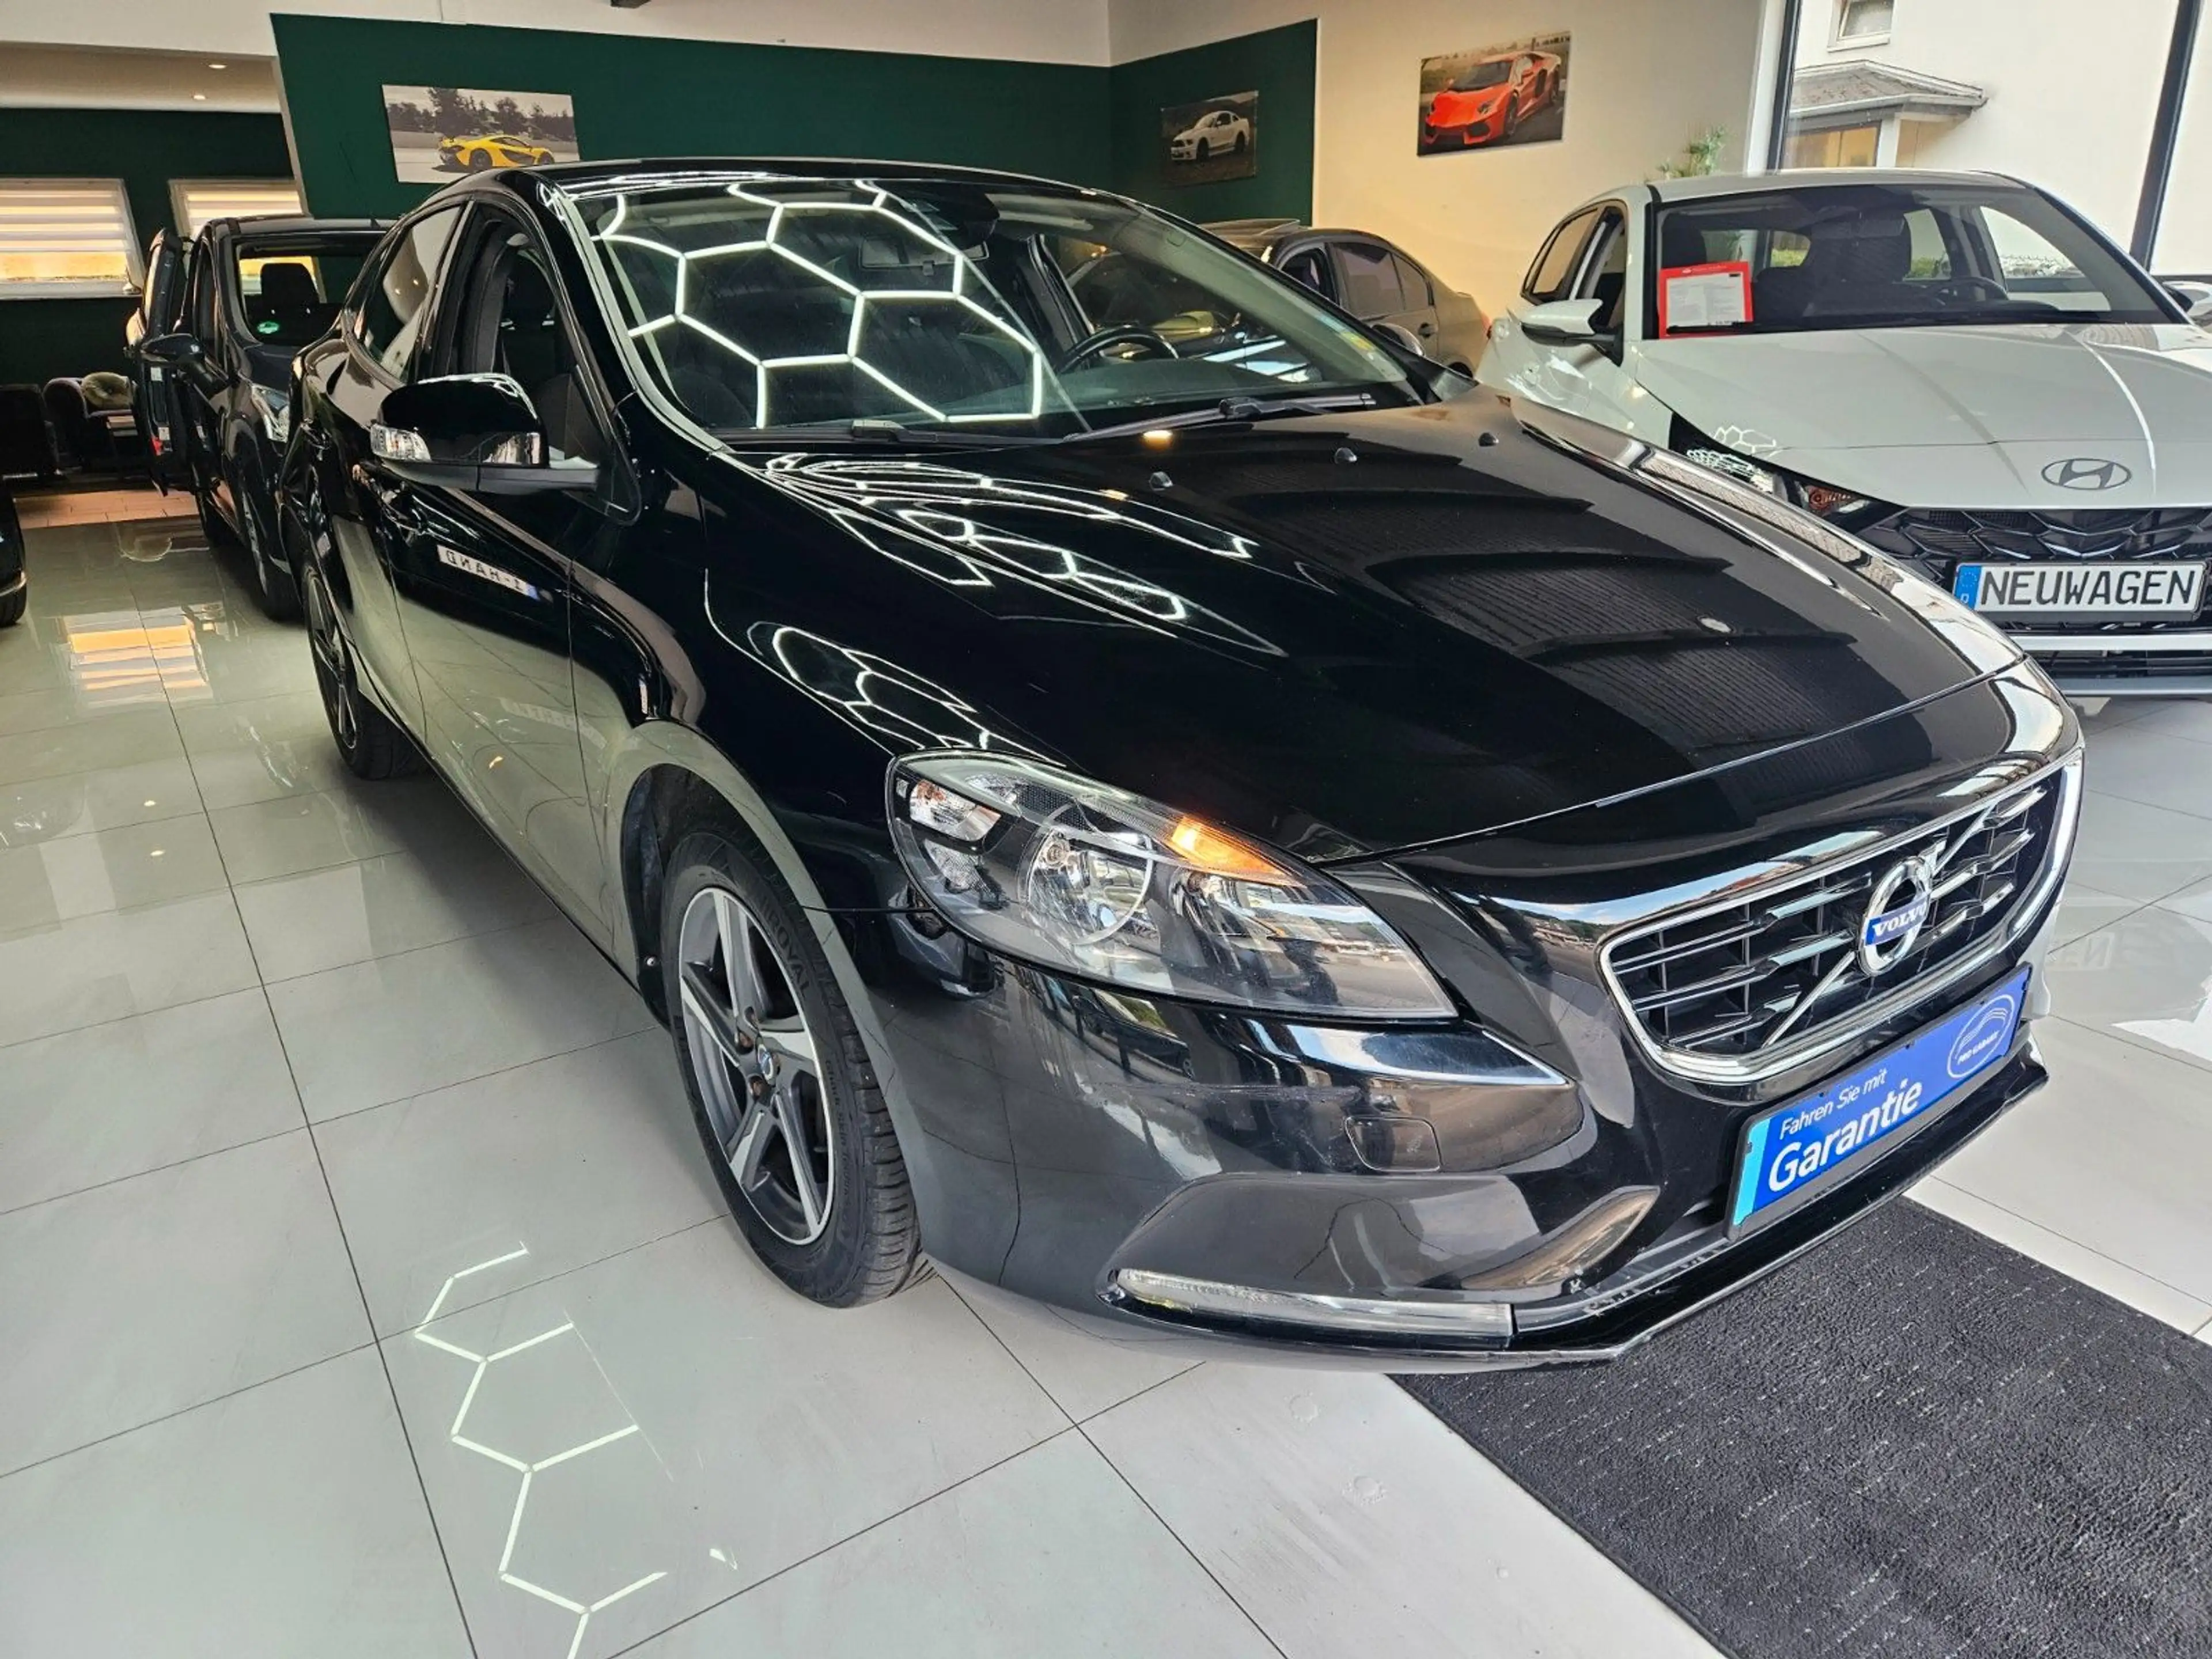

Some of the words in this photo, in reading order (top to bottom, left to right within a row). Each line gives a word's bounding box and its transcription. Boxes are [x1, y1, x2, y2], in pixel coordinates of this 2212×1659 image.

[1980, 570, 2195, 605] NEUWAGEN
[1872, 902, 1926, 937] VOLVO
[1779, 1100, 1834, 1141] Fahren
[1837, 1085, 1860, 1111] Sie
[1861, 1067, 1887, 1097] mit
[1768, 1077, 1923, 1193] Garantie
